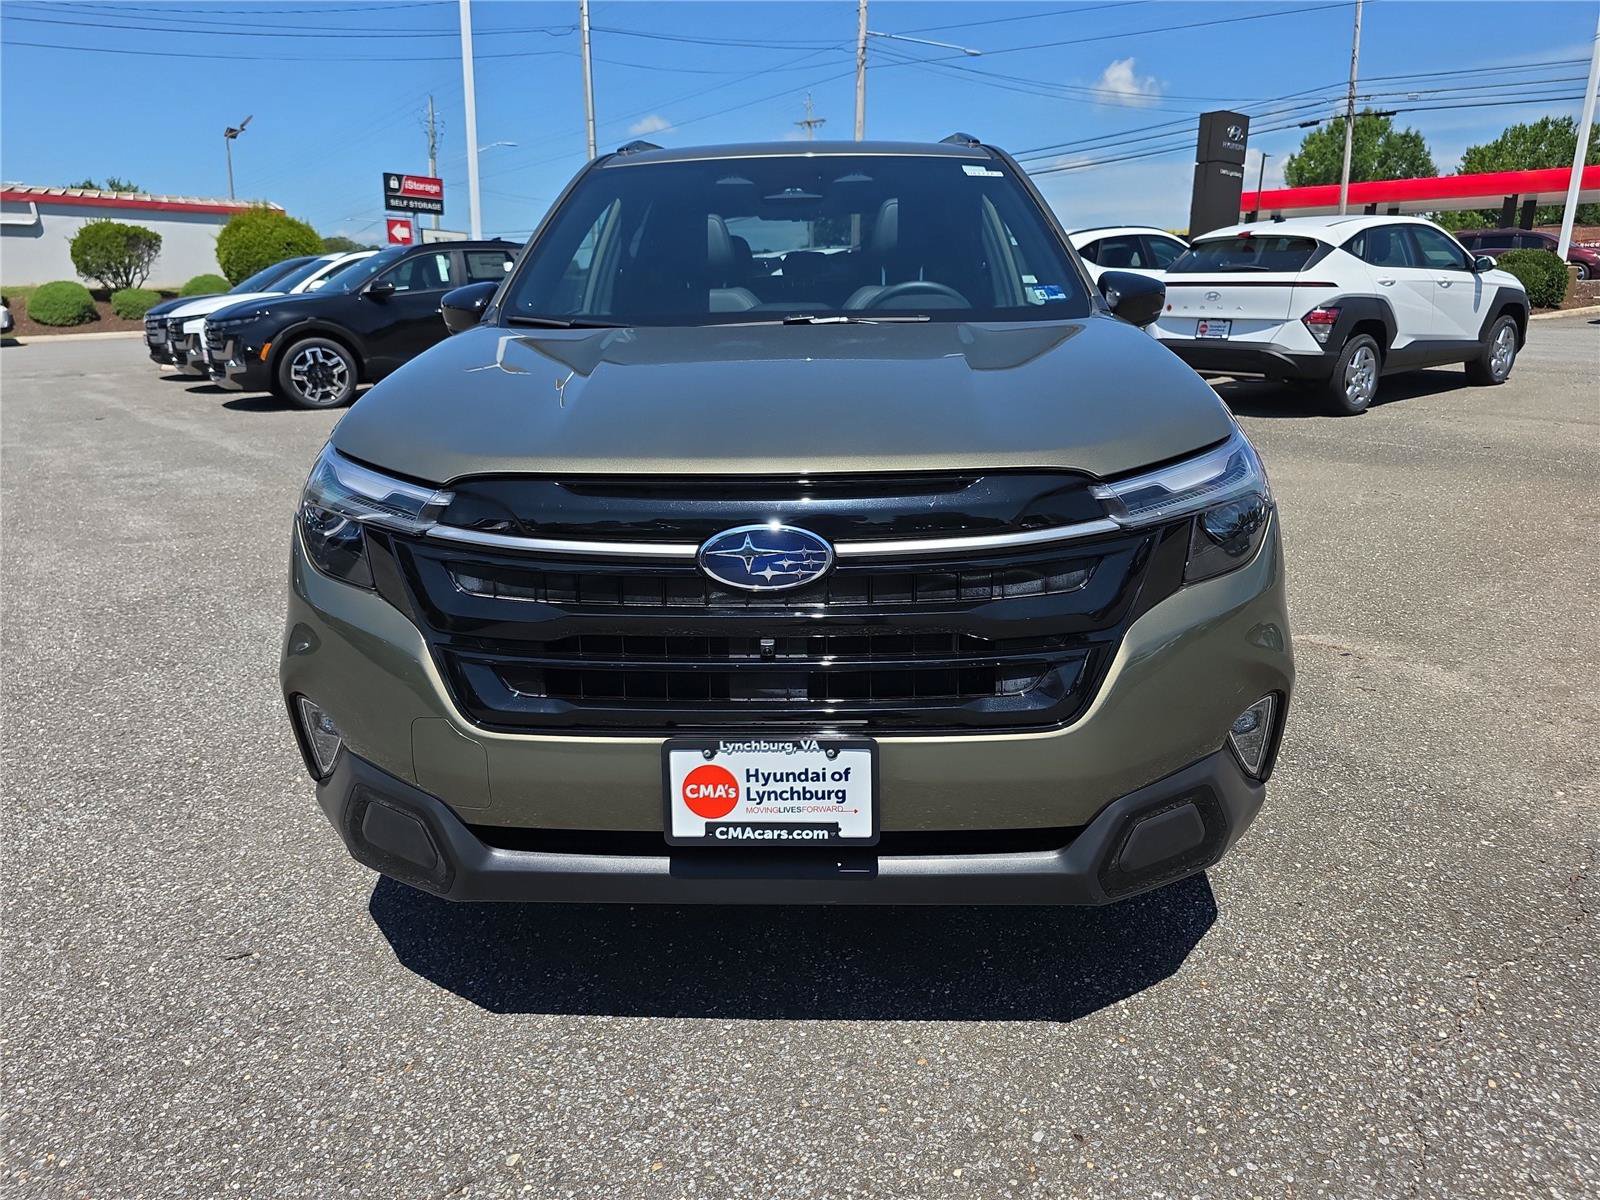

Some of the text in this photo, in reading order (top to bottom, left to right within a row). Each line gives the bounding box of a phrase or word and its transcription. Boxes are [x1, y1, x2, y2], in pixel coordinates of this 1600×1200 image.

[404, 180, 440, 193] iStorage
[390, 199, 441, 211] SELF STORAGE
[719, 740, 820, 754] Lynchburg, VA
[746, 767, 851, 786] Hyundai of
[685, 784, 737, 799] CMA's
[746, 786, 847, 804] Lynchburg
[715, 826, 829, 840] CMAcars.com
